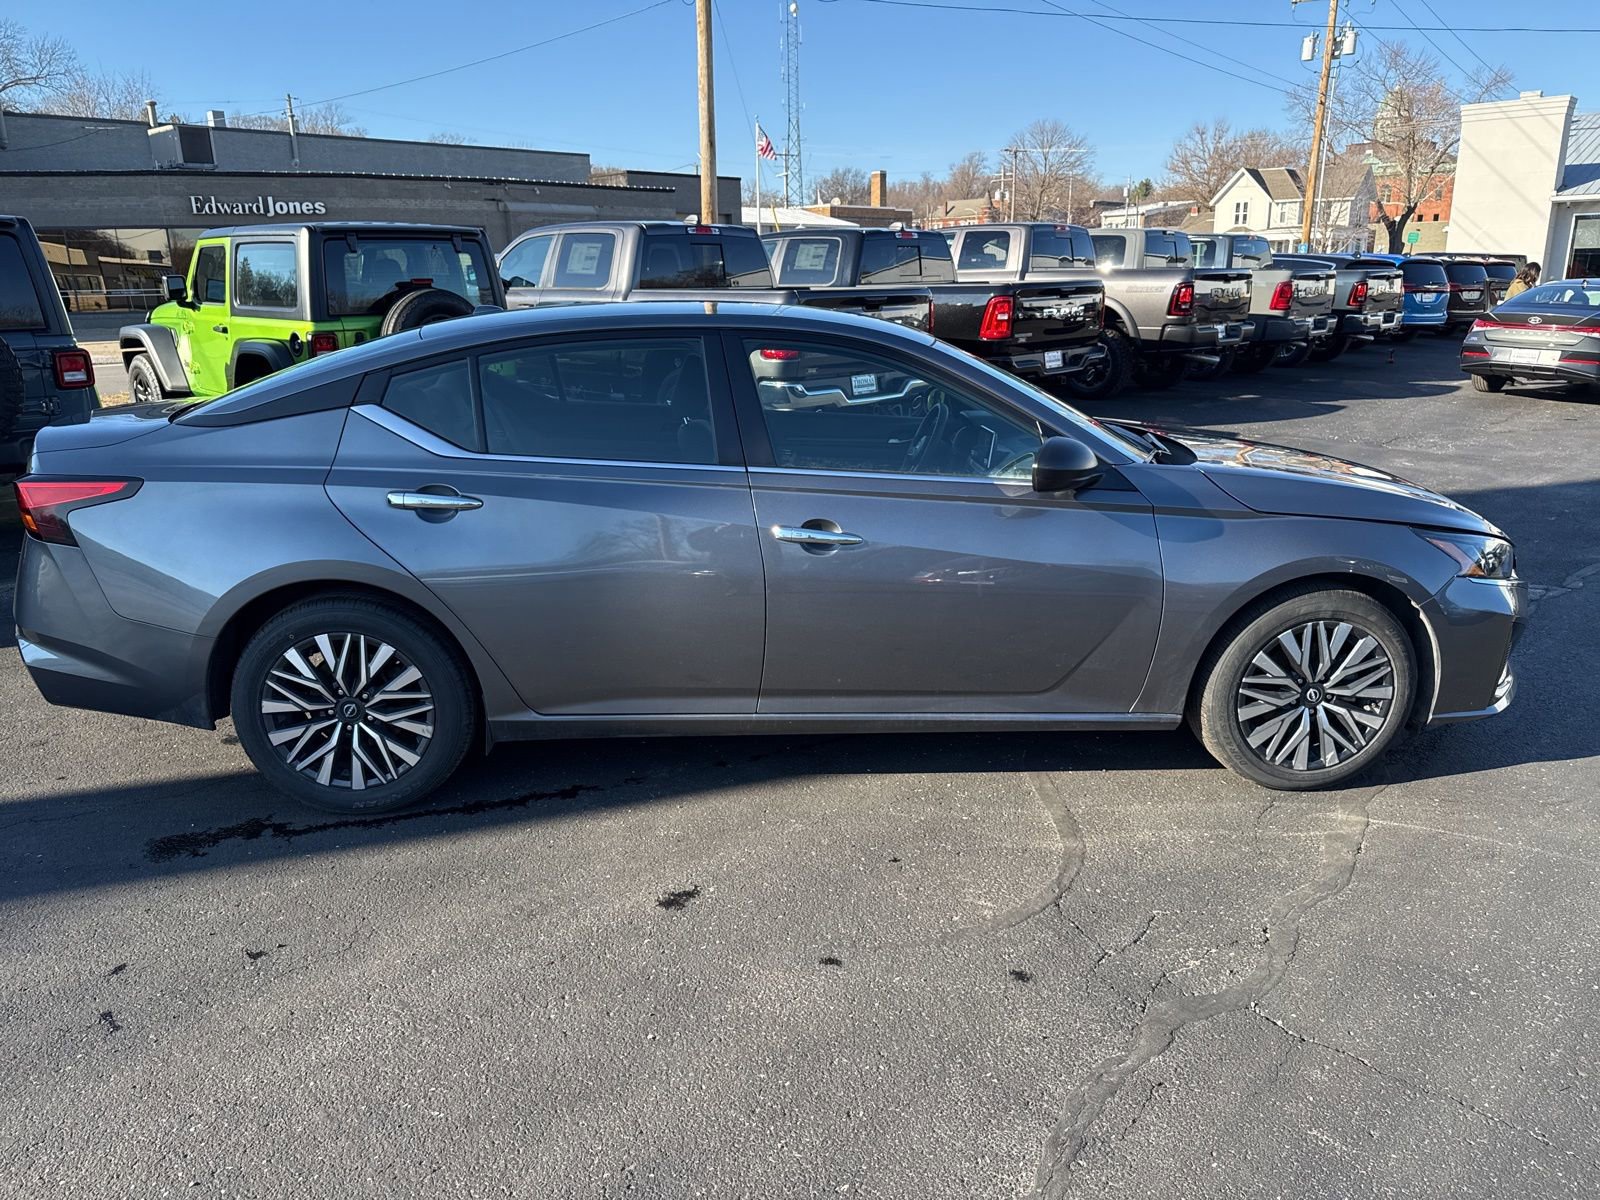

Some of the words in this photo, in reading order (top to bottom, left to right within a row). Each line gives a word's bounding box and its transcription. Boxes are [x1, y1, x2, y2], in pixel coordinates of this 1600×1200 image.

[189, 195, 265, 215] Edward
[267, 196, 327, 217] Jones
[1210, 287, 1242, 299] RAM
[1305, 286, 1329, 297] RAM
